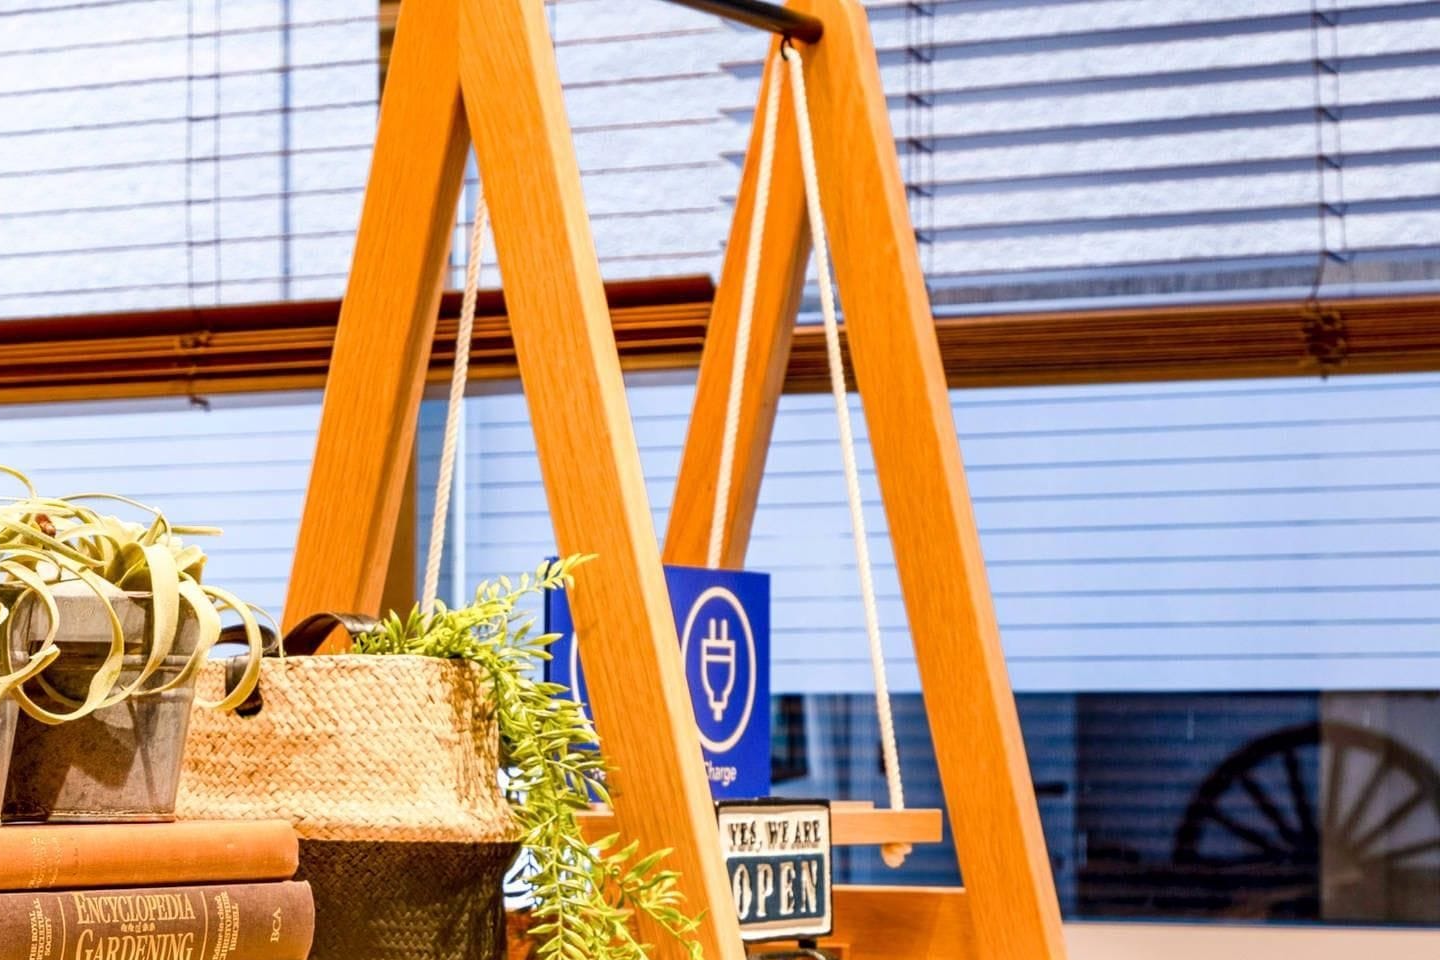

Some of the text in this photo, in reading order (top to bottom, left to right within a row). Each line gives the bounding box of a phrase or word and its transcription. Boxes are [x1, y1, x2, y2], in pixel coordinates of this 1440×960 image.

[765, 820, 788, 848] WE
[793, 819, 821, 848] ARE
[72, 891, 196, 924] ENCYCLOPEDIA
[732, 861, 818, 920] OPEN
[270, 907, 282, 943] BCA
